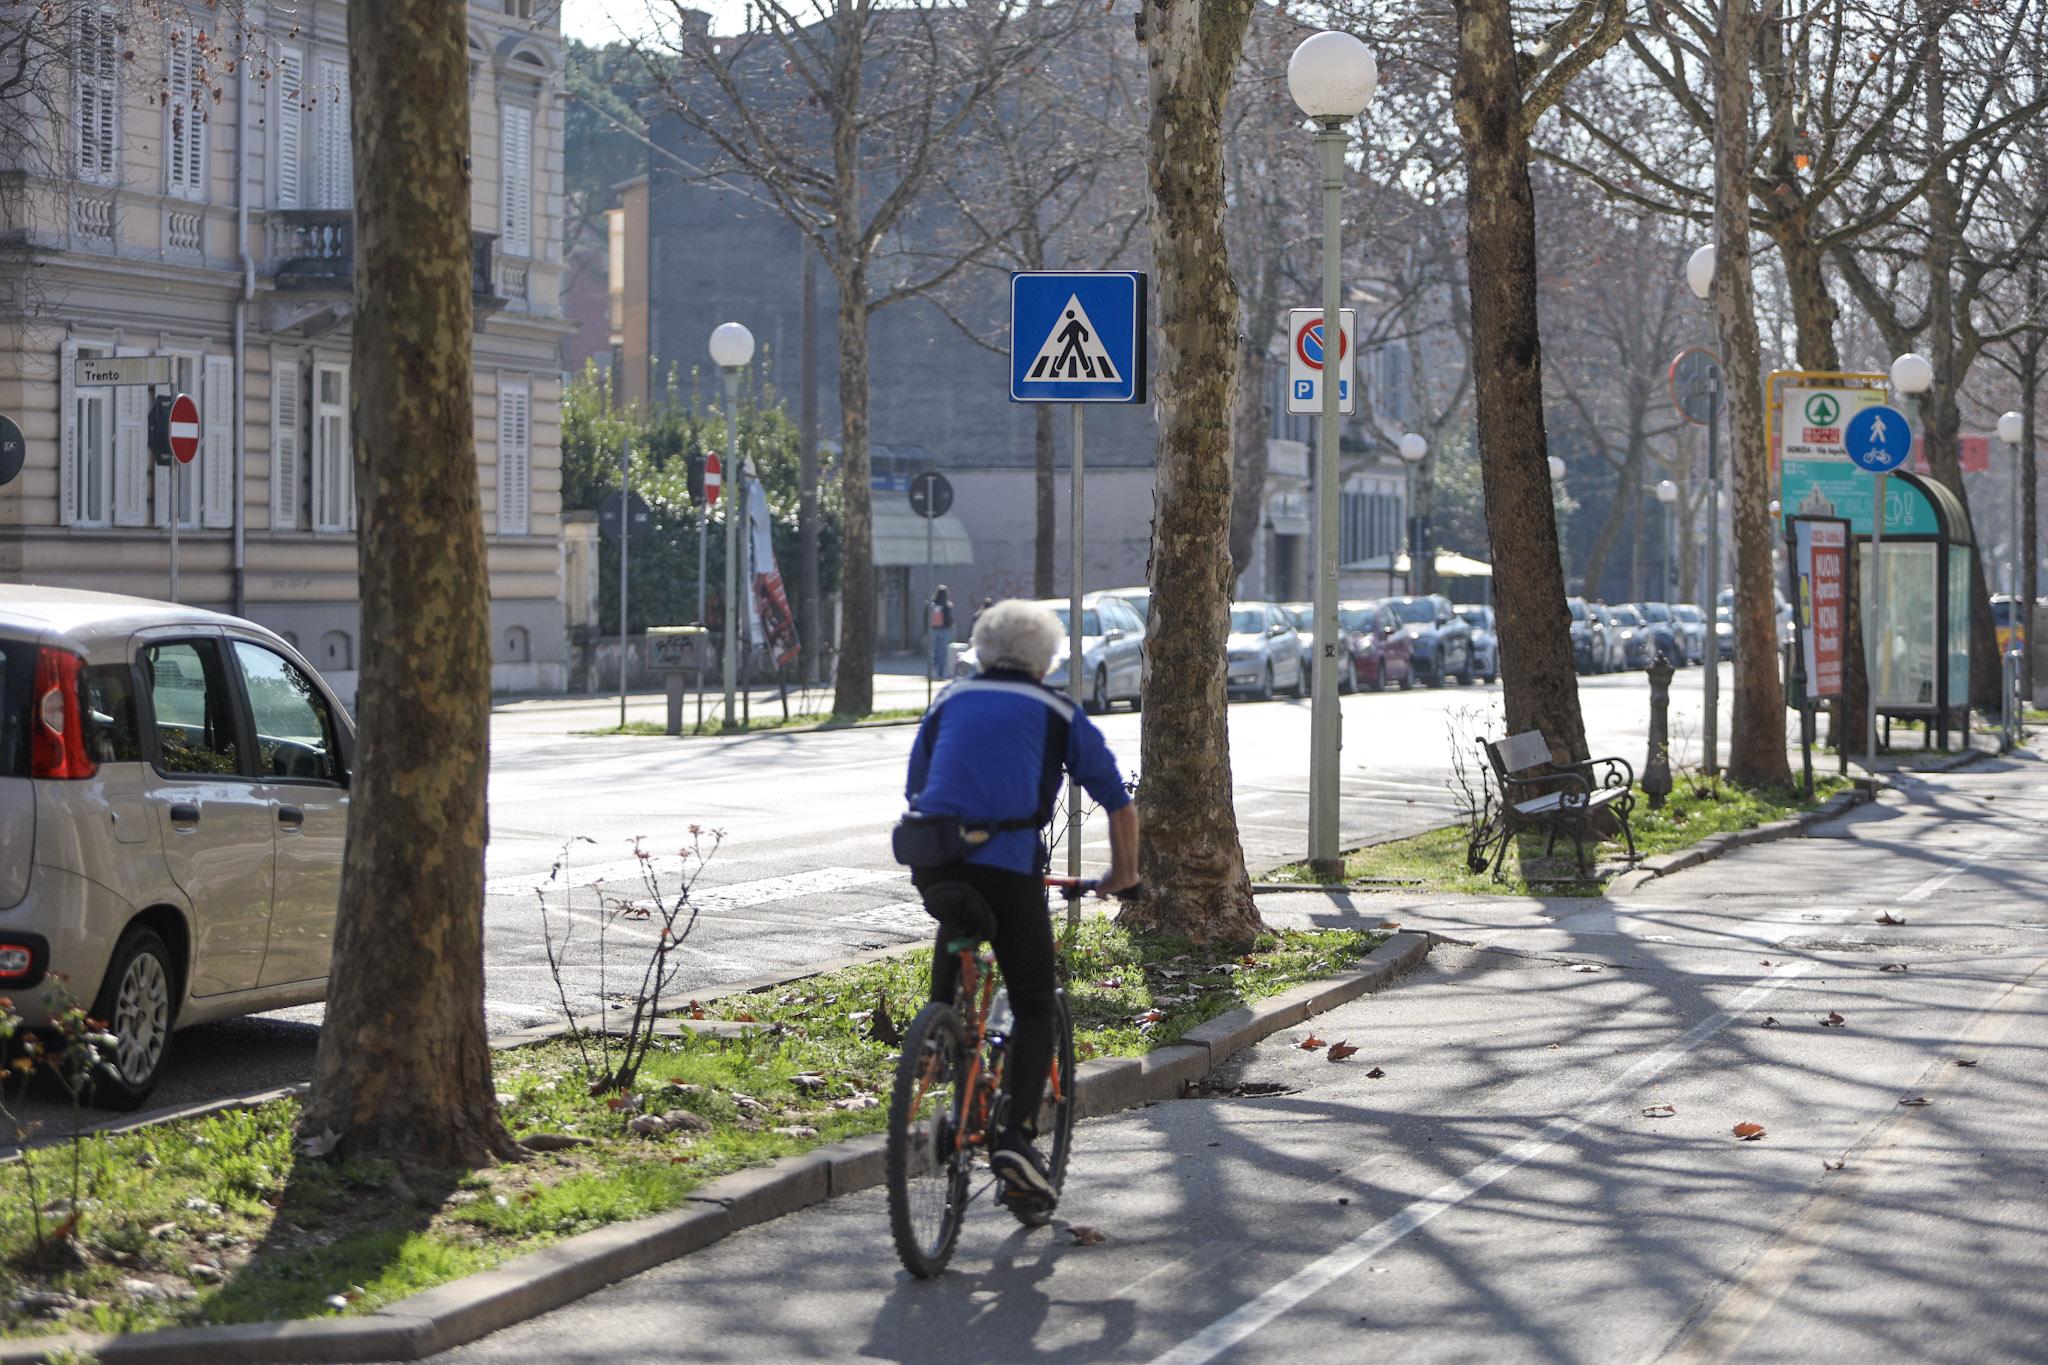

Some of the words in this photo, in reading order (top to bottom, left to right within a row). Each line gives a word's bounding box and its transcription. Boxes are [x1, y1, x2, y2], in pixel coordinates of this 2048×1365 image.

[85, 370, 120, 381] Trento
[1298, 382, 1311, 398] P
[1815, 553, 1841, 577] NUOVA
